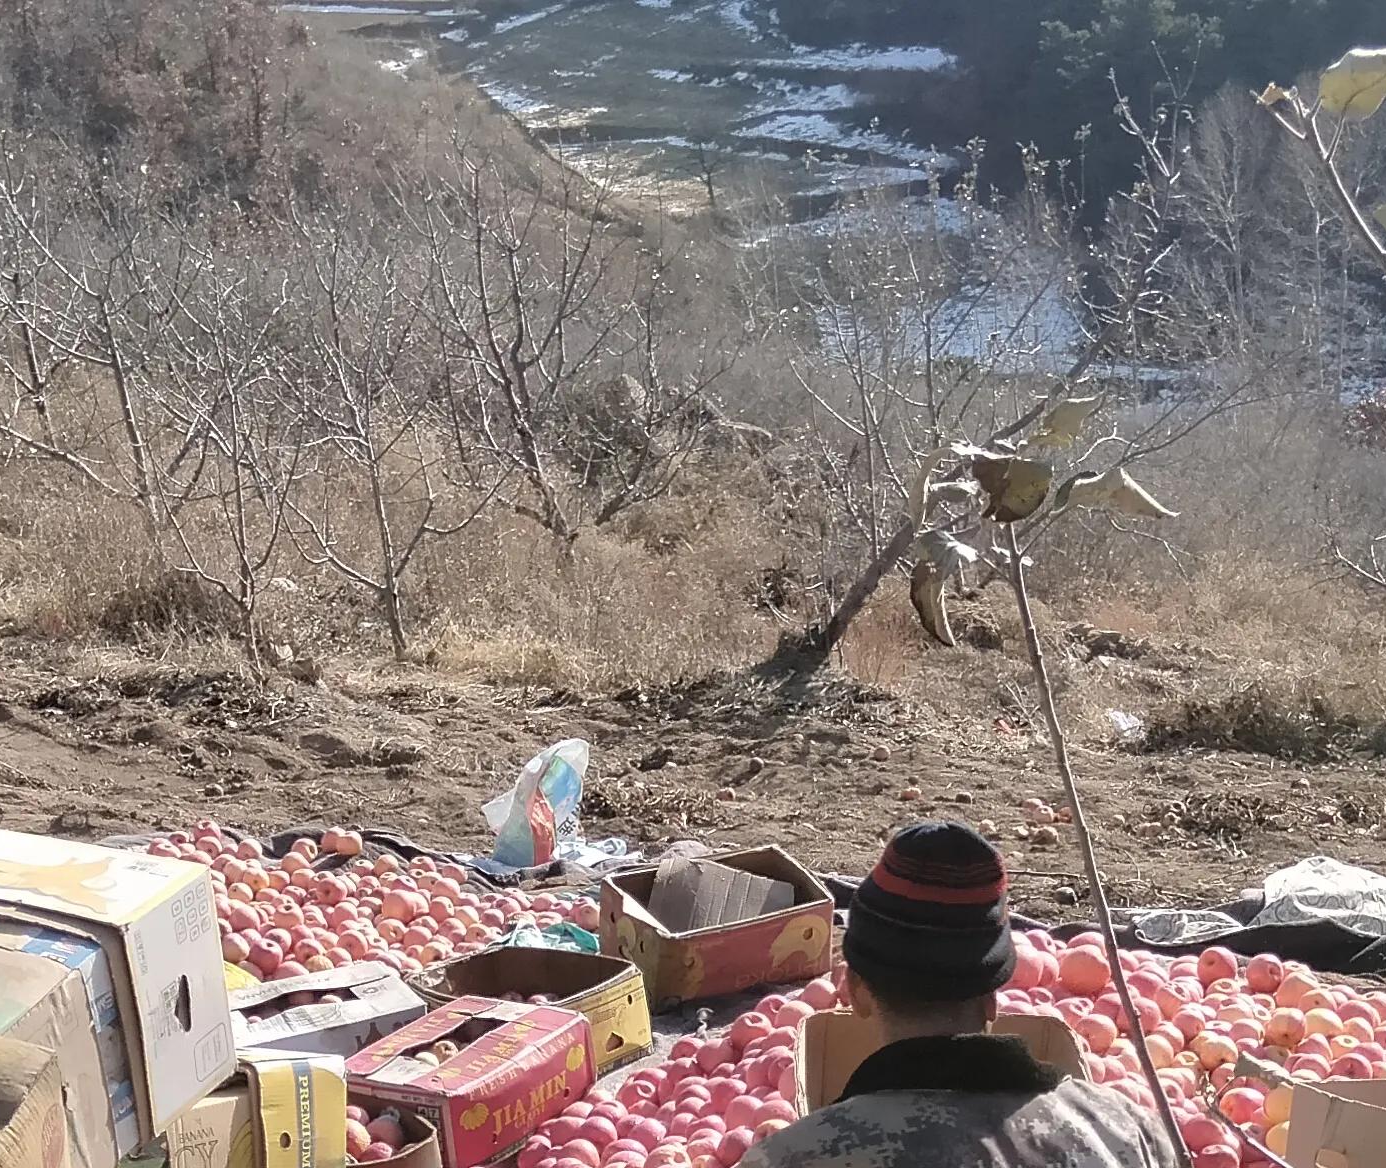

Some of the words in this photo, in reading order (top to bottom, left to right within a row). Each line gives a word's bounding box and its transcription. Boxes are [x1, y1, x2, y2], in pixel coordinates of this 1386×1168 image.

[298, 1075, 312, 1168] PREMIUM
[492, 1100, 526, 1135] JIA
[528, 1070, 567, 1106] MIN
